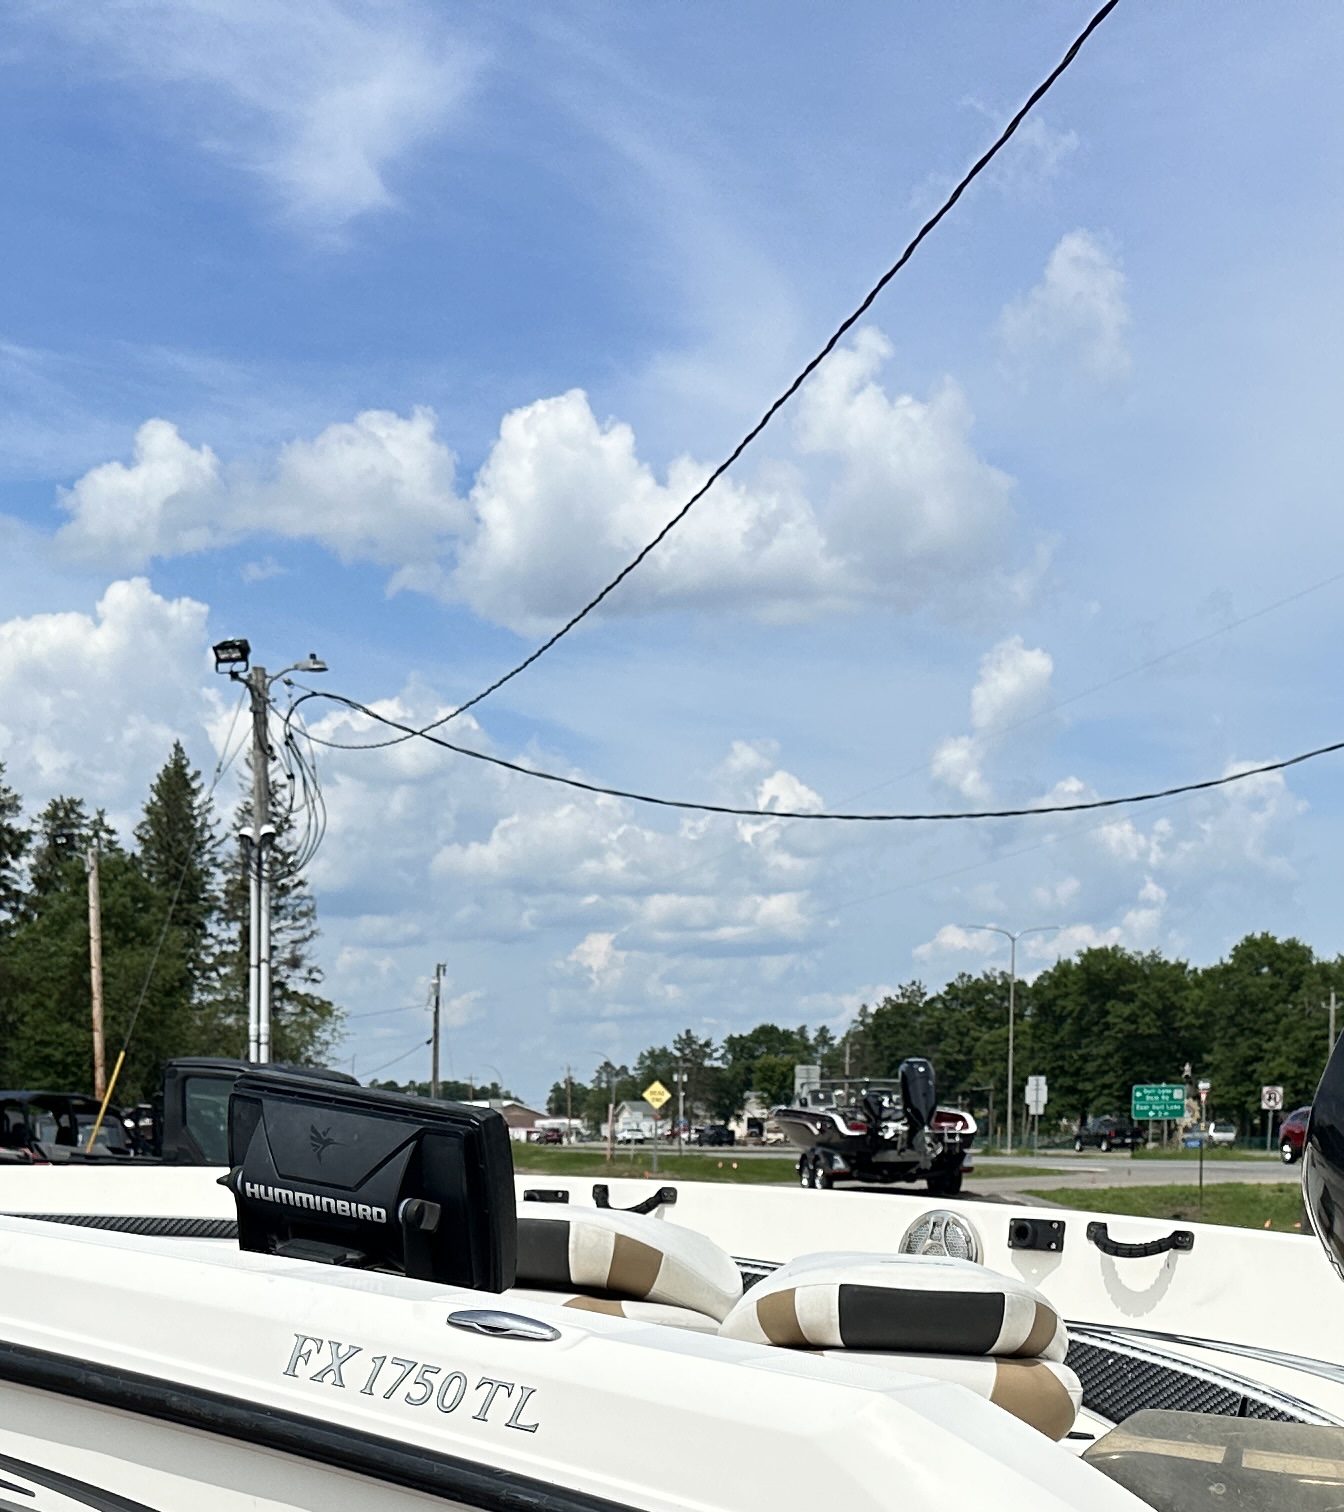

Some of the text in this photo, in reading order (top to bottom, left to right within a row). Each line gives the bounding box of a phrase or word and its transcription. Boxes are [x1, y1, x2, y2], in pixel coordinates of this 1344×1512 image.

[245, 1182, 387, 1224] HUMMINBIRD
[283, 1333, 540, 1434] FX 1750 TL
